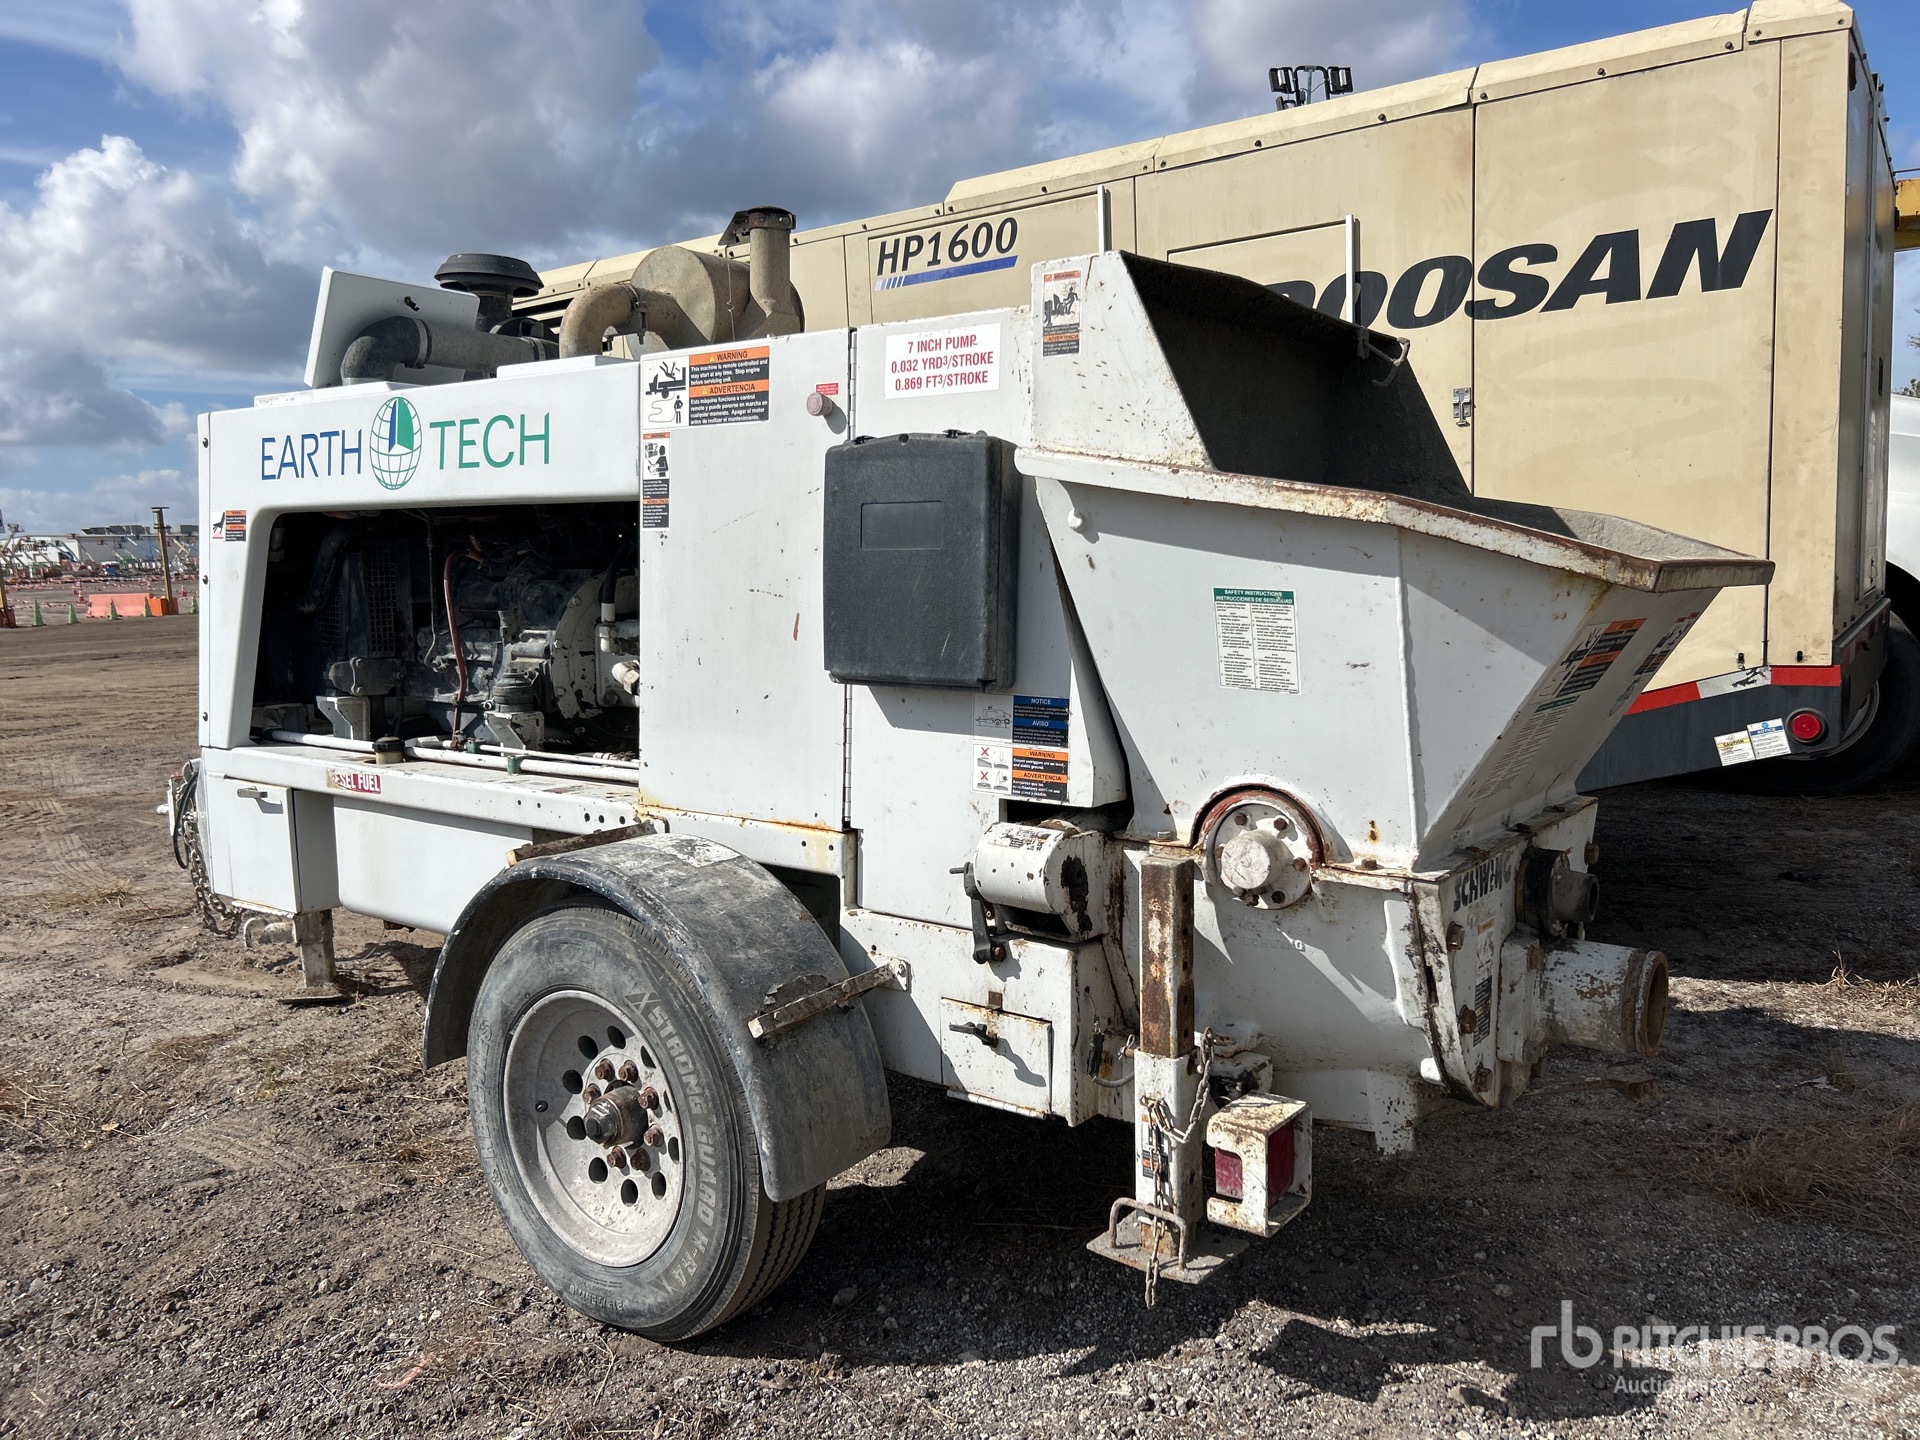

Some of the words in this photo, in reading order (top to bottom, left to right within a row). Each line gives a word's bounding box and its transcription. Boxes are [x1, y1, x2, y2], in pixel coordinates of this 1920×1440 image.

[877, 217, 1018, 277] HP1600
[908, 342, 914, 354] 7
[917, 338, 941, 353] INCH
[945, 334, 977, 350] PUMP
[717, 351, 748, 361] WARNING
[891, 360, 918, 373] 0.032
[710, 383, 755, 394] ADVERTENCIA
[895, 377, 922, 391] 0.869
[261, 428, 362, 482] EARTH
[429, 411, 550, 471] TECH
[1244, 590, 1282, 598] INSTRUCTIONS
[1723, 739, 1745, 747] CAUTION
[1030, 751, 1055, 759] WARNING
[332, 774, 357, 789] ESEL
[358, 774, 380, 791] FUEL
[1024, 772, 1061, 782] ADVERTENCIA
[648, 1006, 709, 1115] STRONG
[696, 1121, 718, 1227] GUARD
